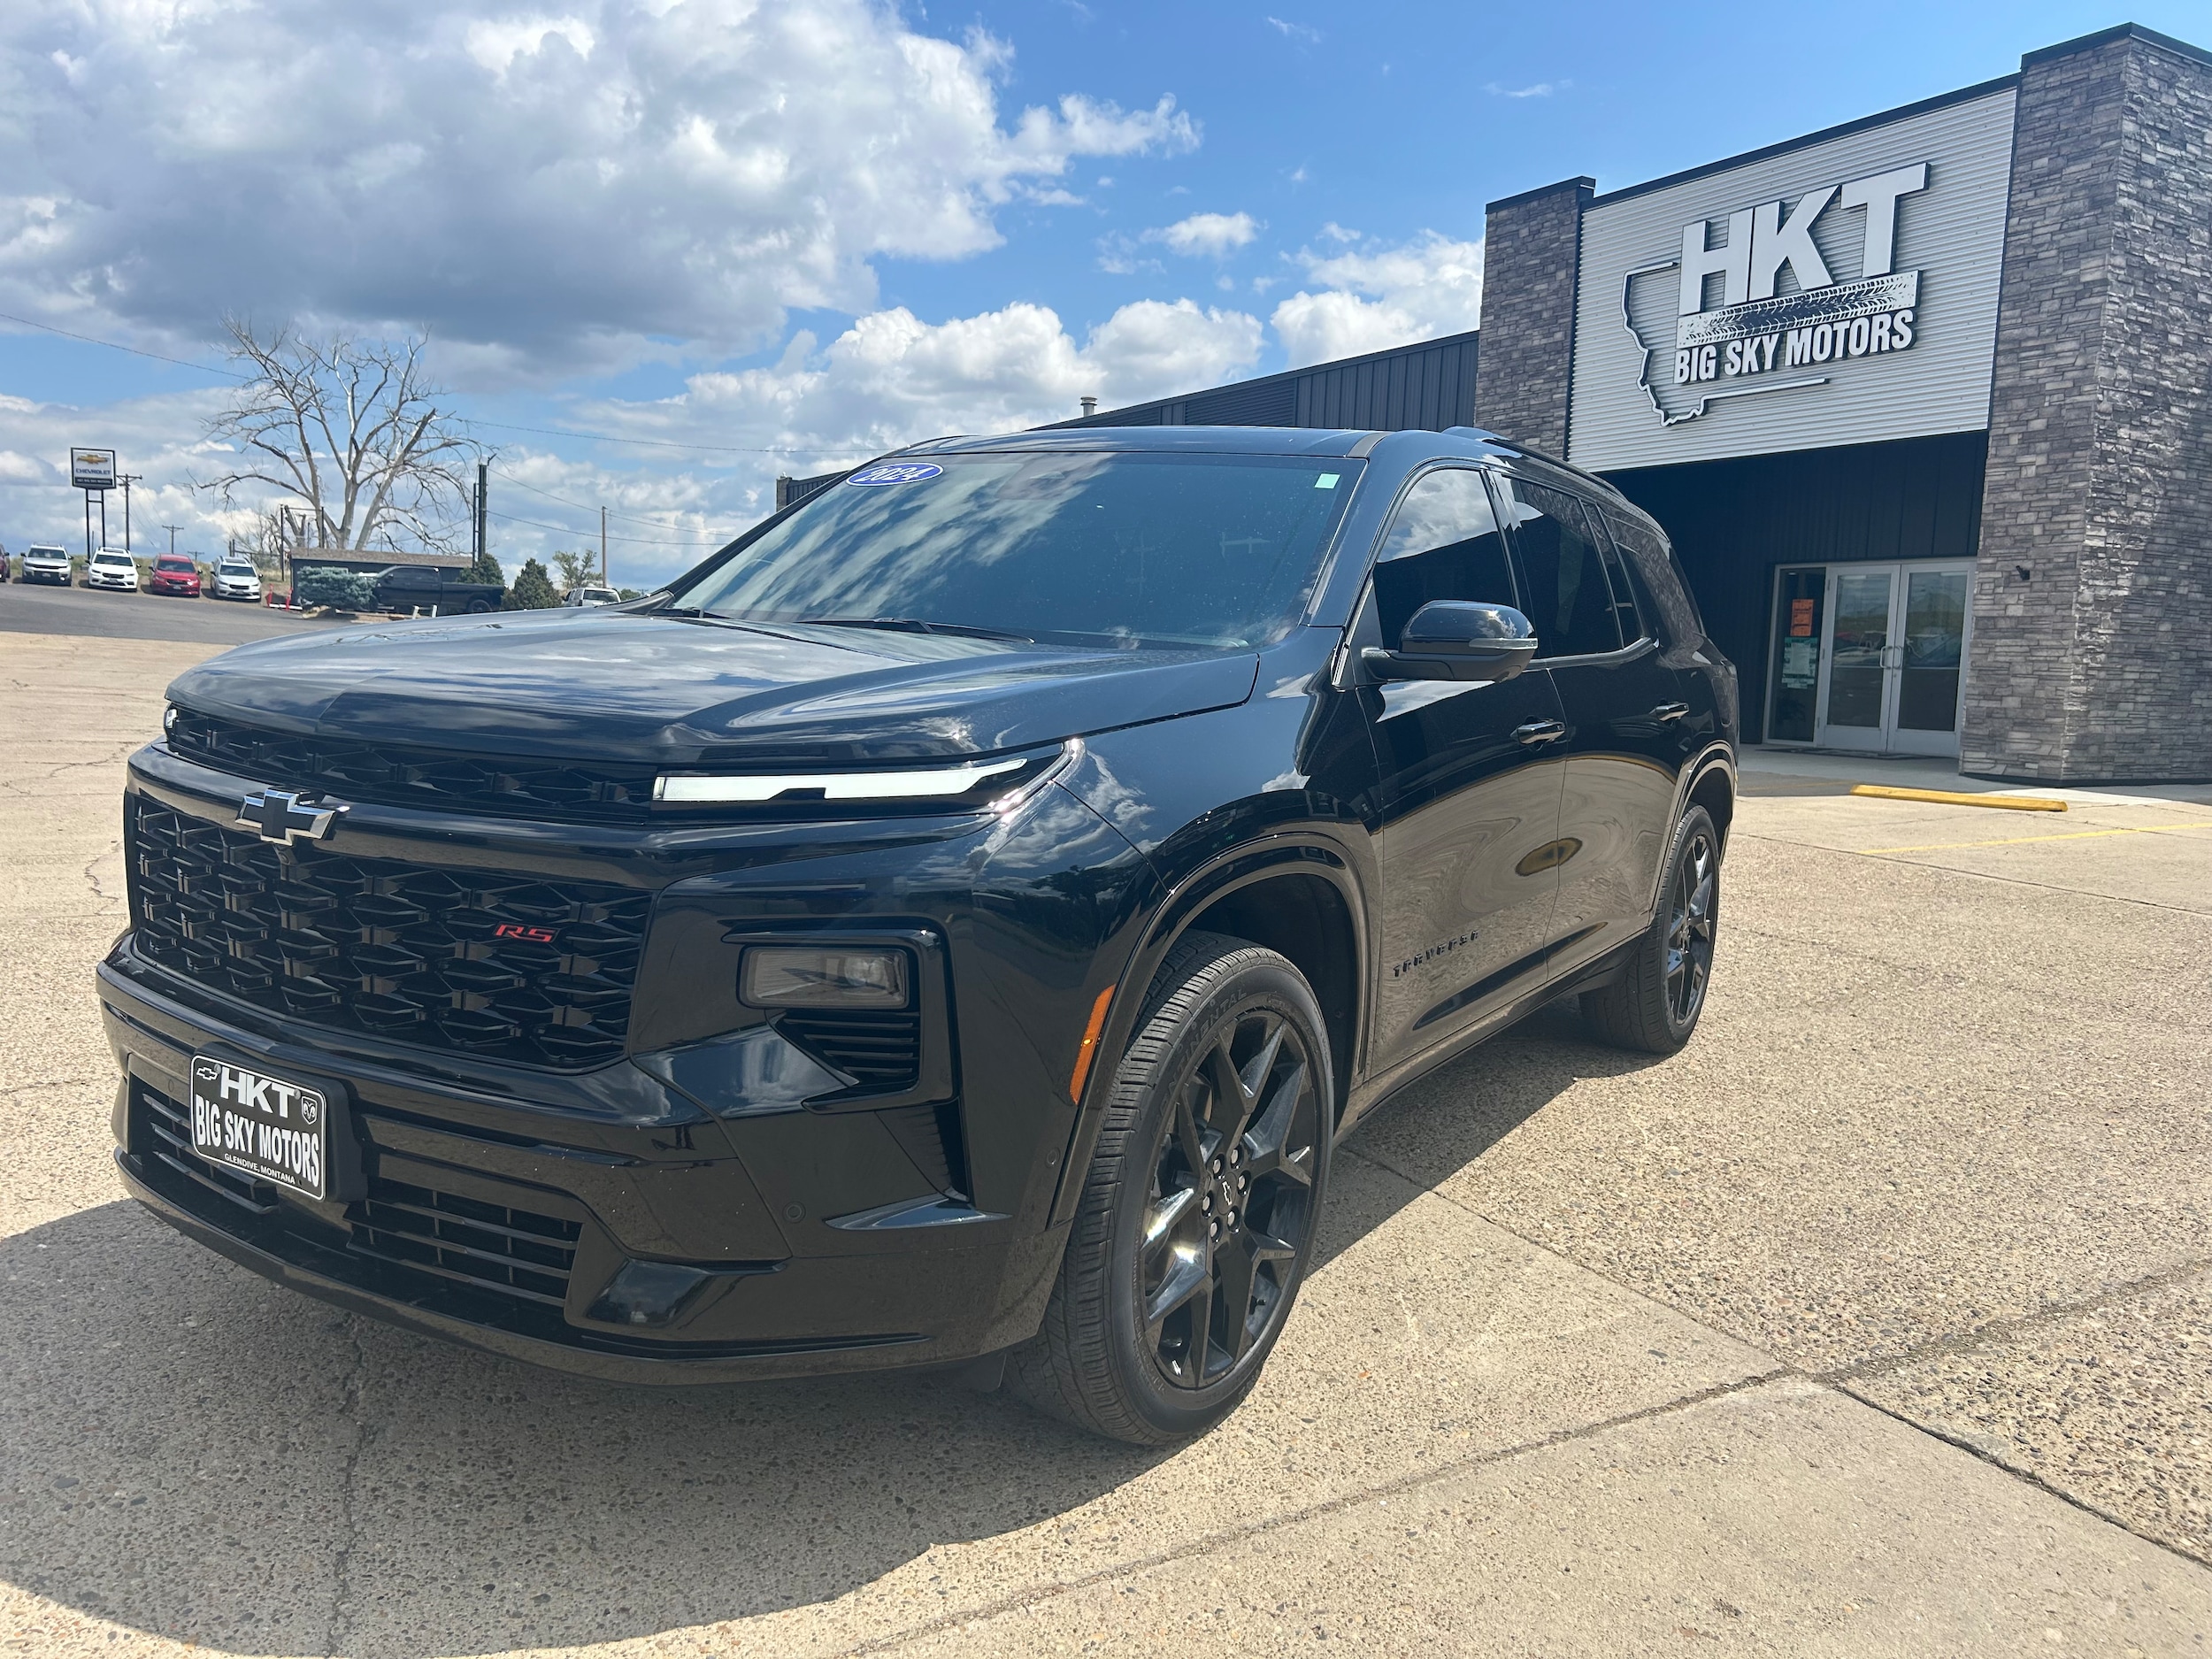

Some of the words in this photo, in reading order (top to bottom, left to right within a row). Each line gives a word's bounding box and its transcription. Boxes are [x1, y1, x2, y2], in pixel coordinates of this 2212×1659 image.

[1678, 163, 1928, 315] HKT
[1674, 346, 1717, 384] BIG
[1724, 333, 1780, 376] SKY
[1785, 310, 1915, 366] MOTORS
[854, 466, 934, 481] 2024
[495, 924, 557, 942] RS
[1393, 930, 1479, 977] TRAVERSE
[220, 1066, 295, 1118] HKT
[195, 1094, 221, 1148] BIG
[224, 1110, 256, 1154] SKY
[259, 1122, 319, 1187] MOTORS
[224, 1153, 260, 1172] GLENDIVE,
[260, 1164, 296, 1185] MONTANA
